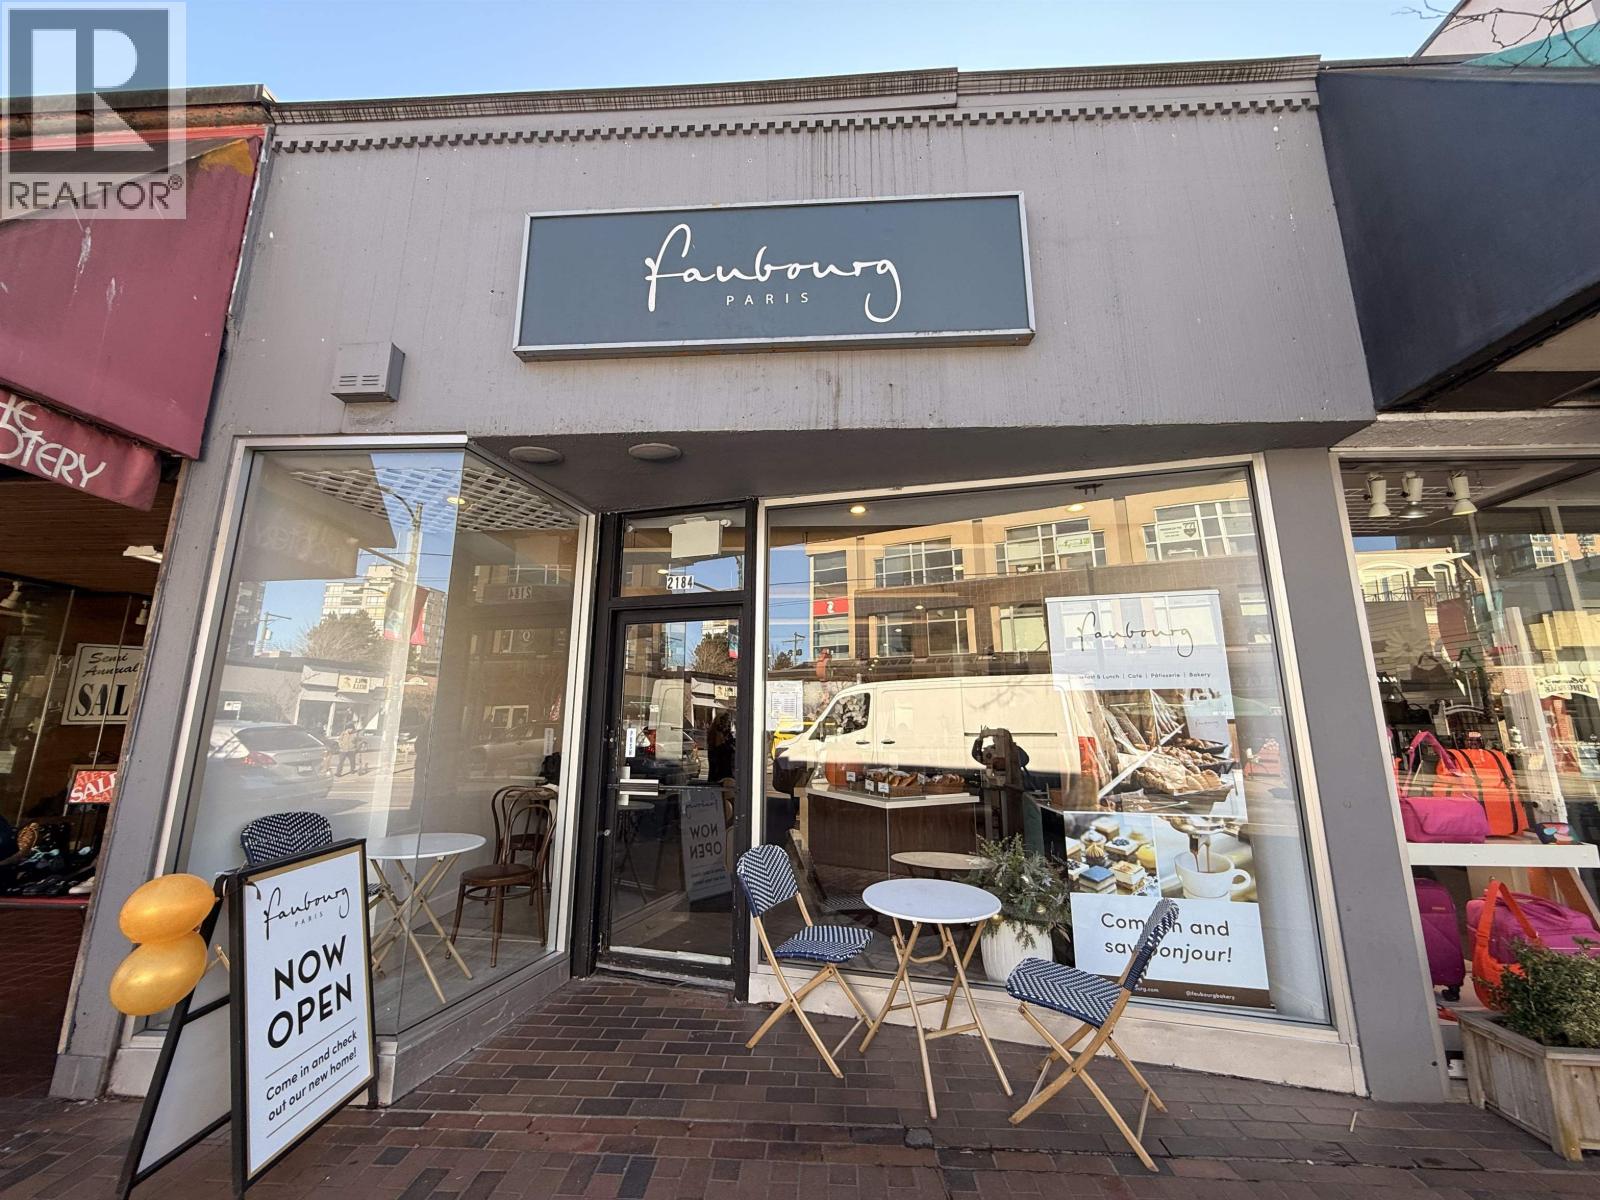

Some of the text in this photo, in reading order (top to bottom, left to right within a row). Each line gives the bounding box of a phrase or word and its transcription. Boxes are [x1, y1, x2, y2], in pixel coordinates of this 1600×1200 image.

[644, 223, 902, 323] faubourg
[726, 292, 809, 306] PARIS
[667, 576, 694, 589] 2184
[1077, 611, 1194, 658] faubourg
[82, 662, 141, 677] Annual
[88, 652, 129, 664] Semi
[1188, 670, 1212, 678] Bakery
[74, 683, 129, 717] SAL
[263, 886, 350, 941] faubourg
[294, 911, 324, 928] PARIS
[1101, 913, 1146, 930] Com
[1190, 920, 1230, 937] and
[274, 934, 347, 1001] NOW
[267, 973, 352, 1049] OPEN
[266, 1030, 357, 1101] Come in and check
[268, 1046, 357, 1121] out our new home!
